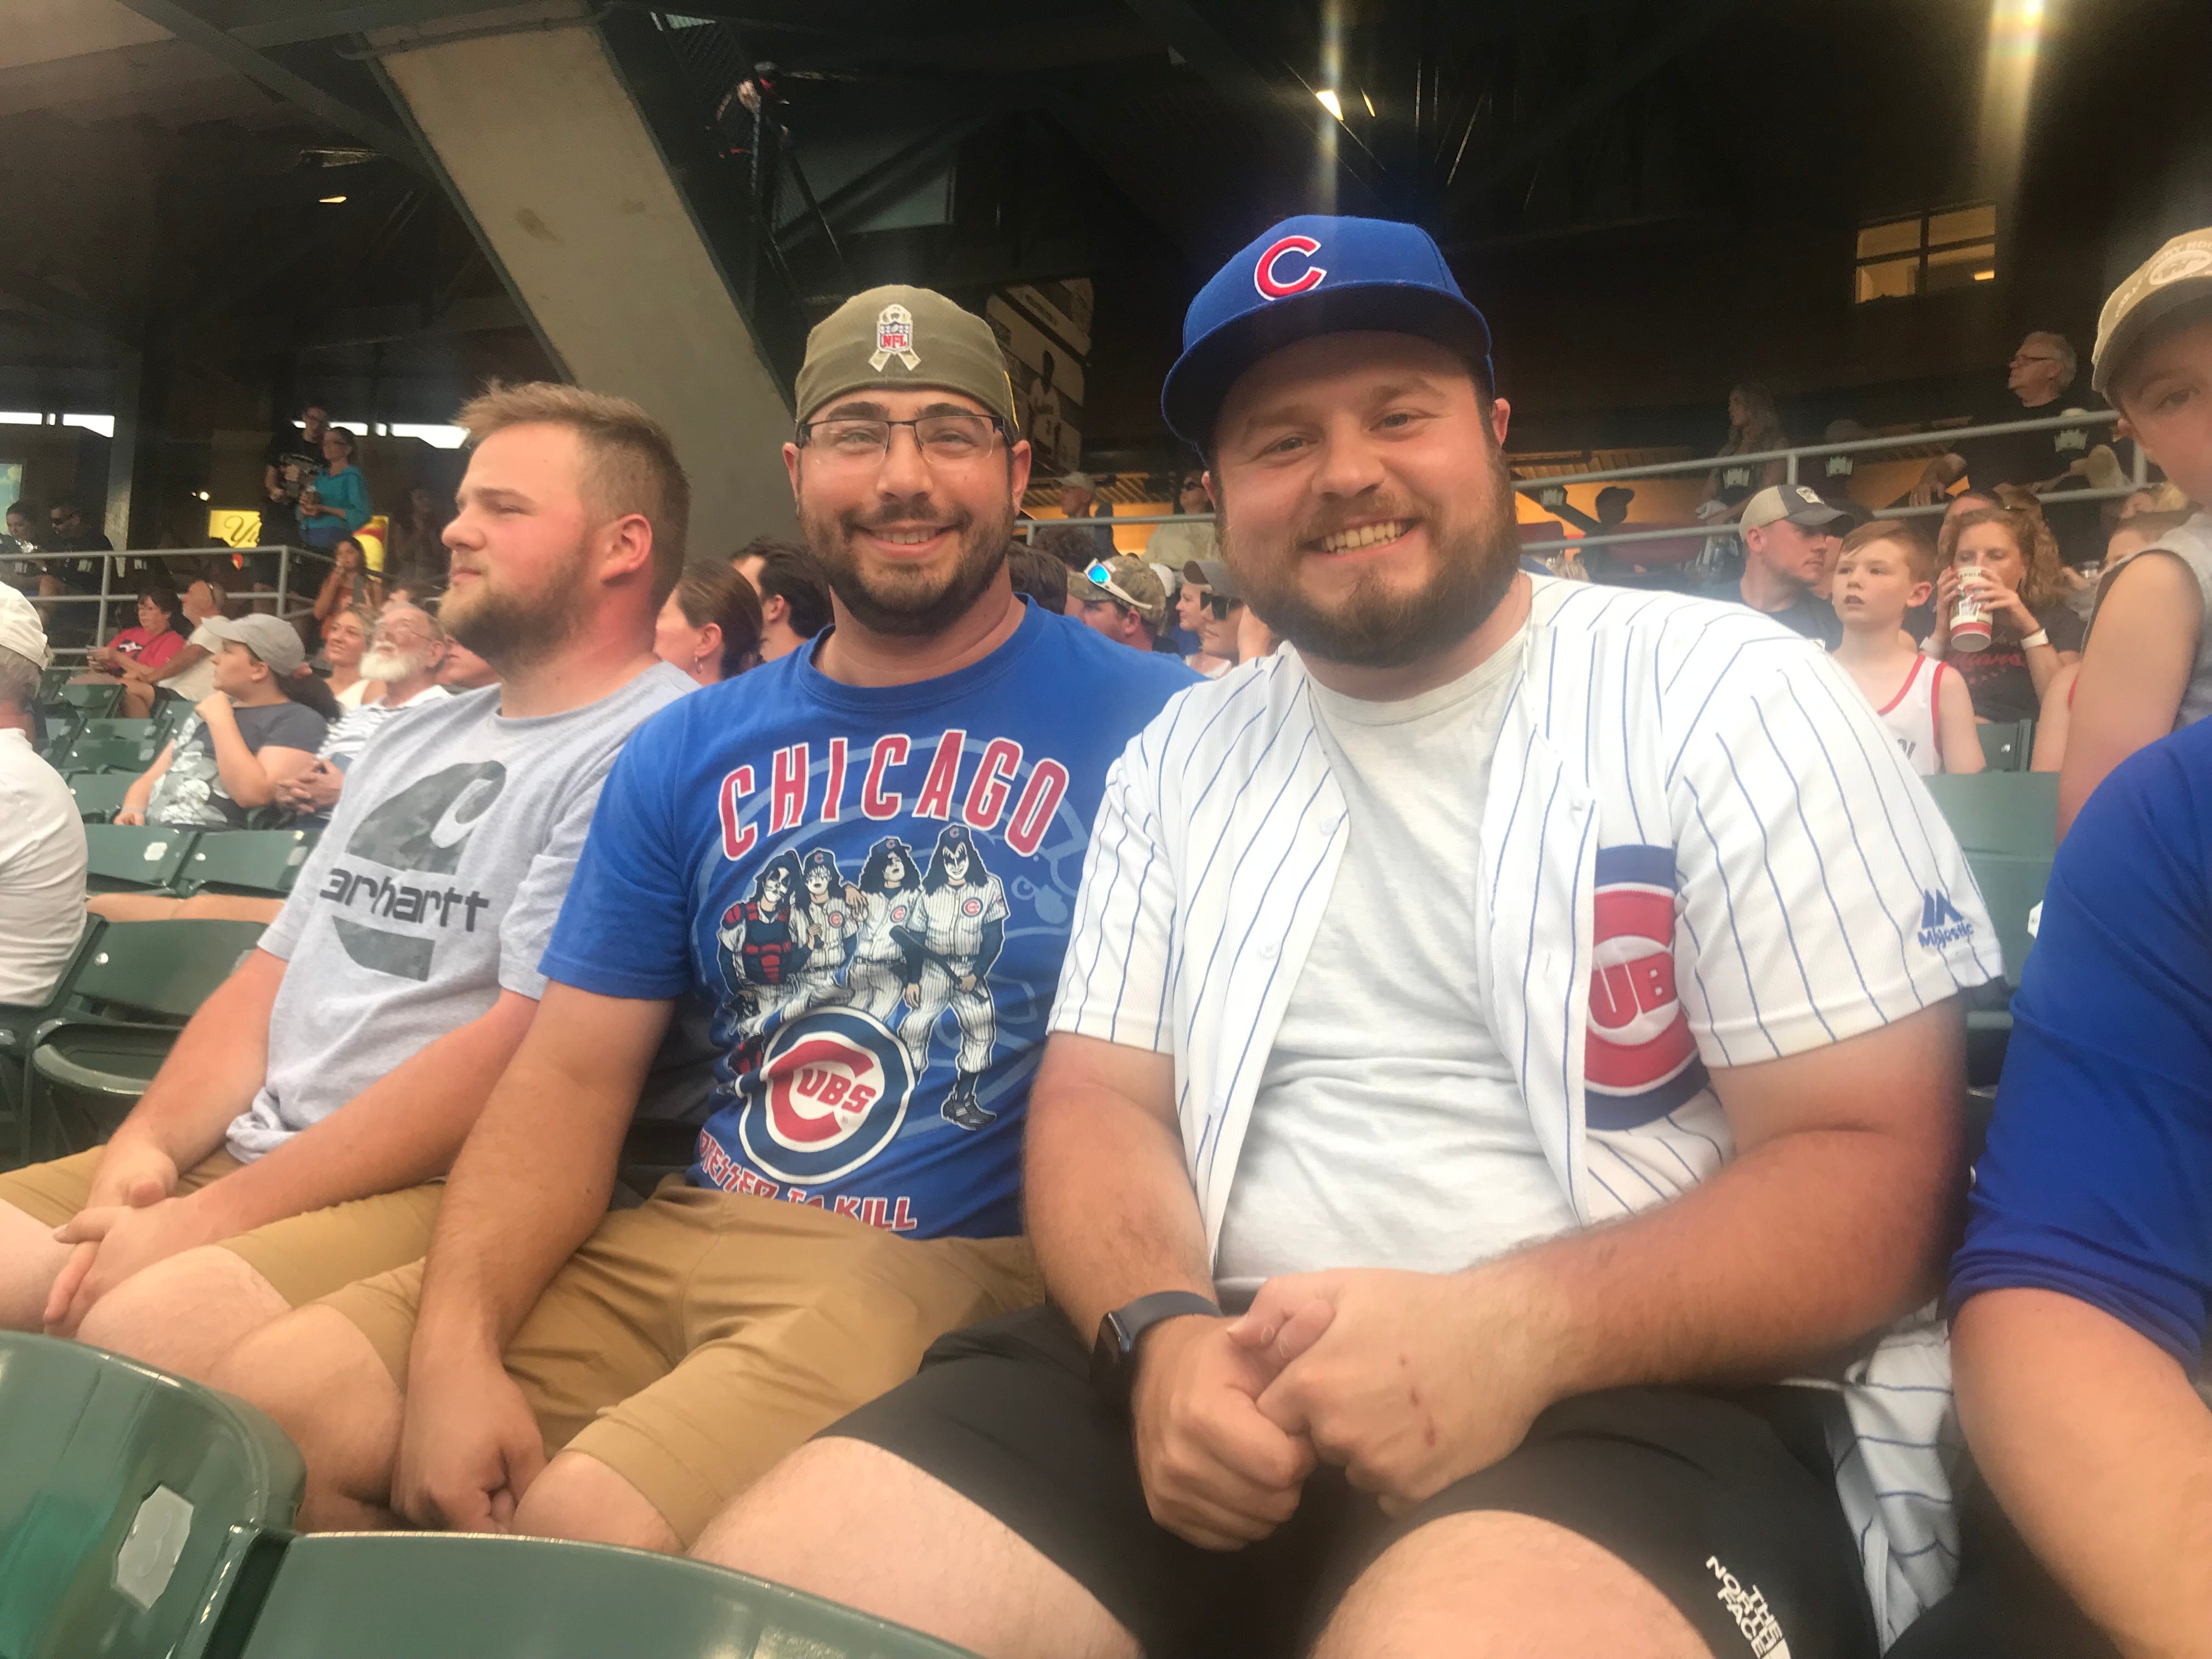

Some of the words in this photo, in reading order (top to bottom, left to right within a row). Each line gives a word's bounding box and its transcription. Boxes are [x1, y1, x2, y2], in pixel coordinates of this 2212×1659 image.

[1254, 235, 1327, 301] C
[882, 335, 907, 348] NFL
[719, 729, 1069, 861] CHICAGO
[833, 1194, 918, 1232] KILL
[1706, 1555, 1778, 1654] NORTH
[1717, 1587, 1765, 1659] FACE
[1750, 1584, 1783, 1640] THE
